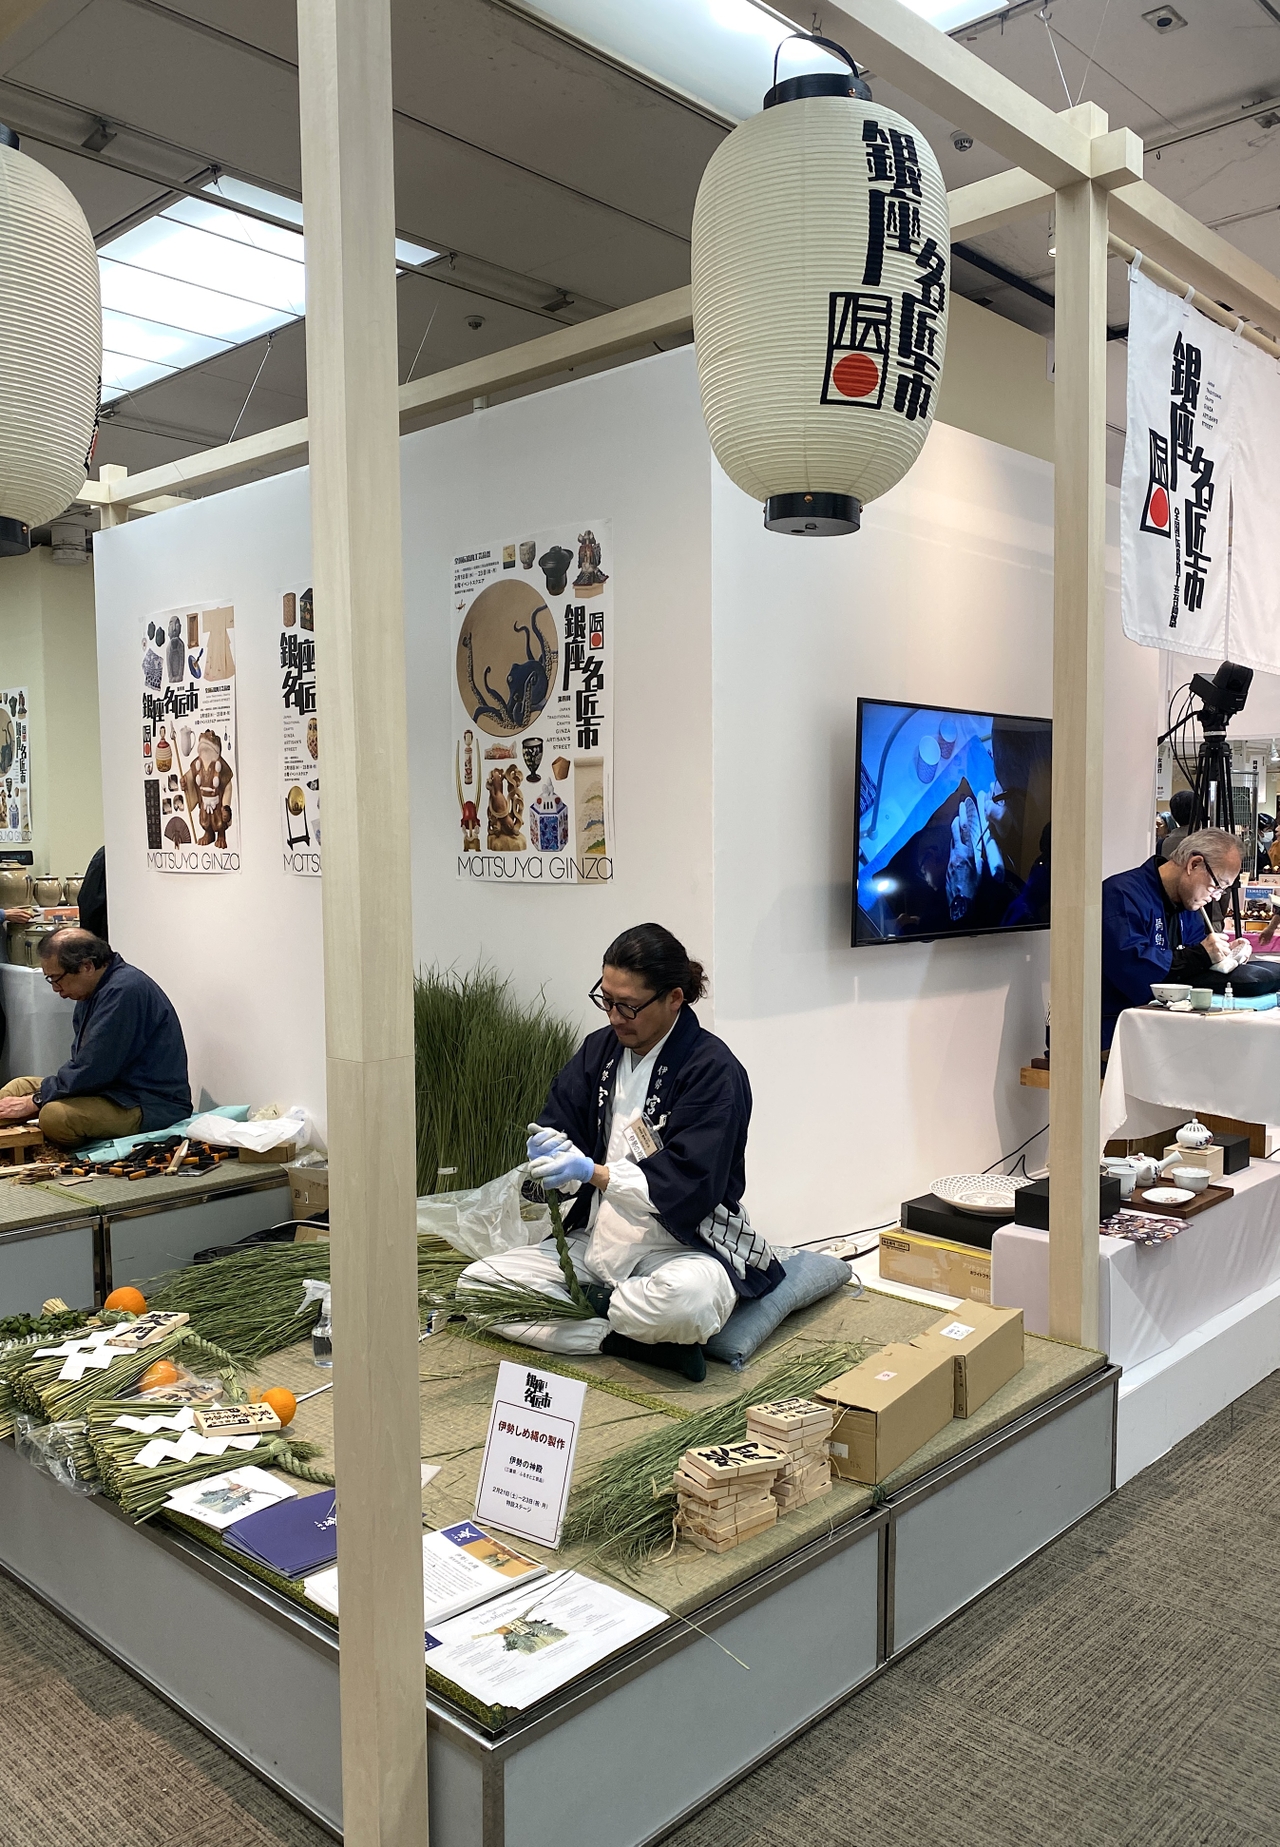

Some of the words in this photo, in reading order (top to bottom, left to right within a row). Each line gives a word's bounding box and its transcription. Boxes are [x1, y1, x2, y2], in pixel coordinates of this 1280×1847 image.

[498, 1420, 566, 1450] 伊勢しめ縄の製作
